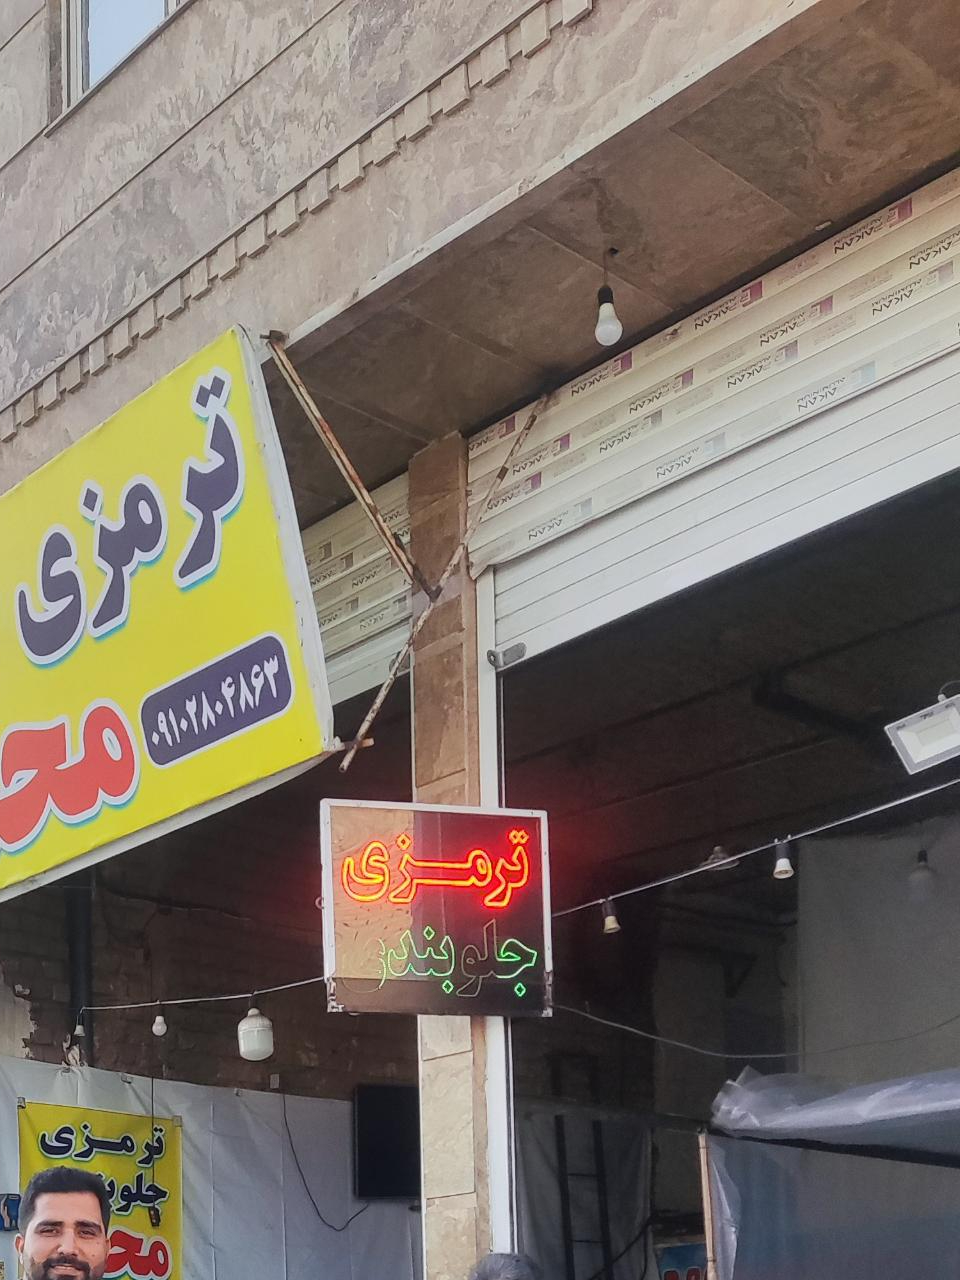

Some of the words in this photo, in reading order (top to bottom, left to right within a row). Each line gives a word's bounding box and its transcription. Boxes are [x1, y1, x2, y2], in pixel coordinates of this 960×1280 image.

[873, 288, 914, 316] AKAN
[798, 387, 837, 412] AKAN
[18, 377, 240, 657] ترمزی
[151, 654, 279, 747] ۰۹۱۰۲۸۰۴۸۶۳
[341, 829, 530, 908] ترمزی
[39, 1122, 165, 1165] ترمزی
